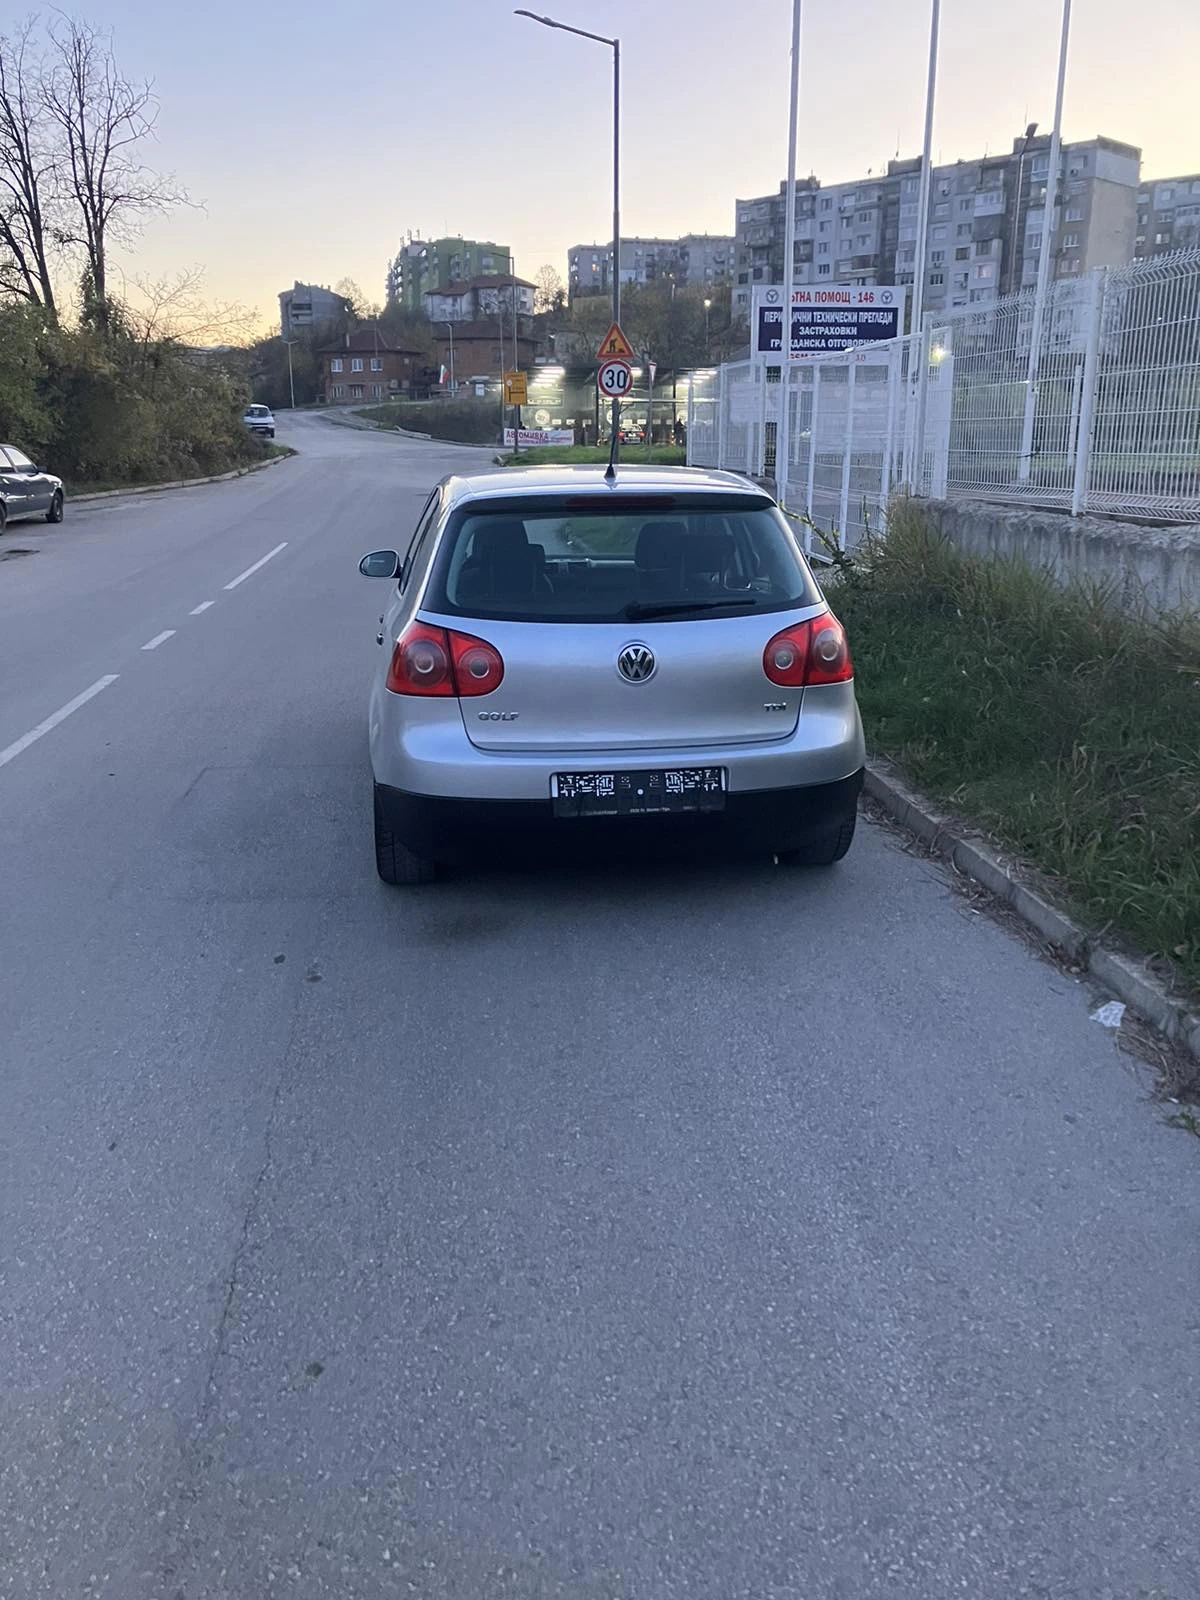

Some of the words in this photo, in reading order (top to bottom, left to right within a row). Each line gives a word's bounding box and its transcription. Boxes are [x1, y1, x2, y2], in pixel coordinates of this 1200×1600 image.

[814, 291, 851, 304] ПОМОЩ
[857, 292, 874, 303] 146
[813, 311, 858, 323] ТЕХНИЧЕСКИ
[858, 311, 893, 325] ПРЕГЛЕДИ
[799, 326, 857, 335] ЗАСТРАХОВКИ
[605, 369, 627, 389] 30
[506, 430, 549, 440] АВОМИВКА
[619, 644, 654, 681] VW
[478, 711, 520, 721] GOLF
